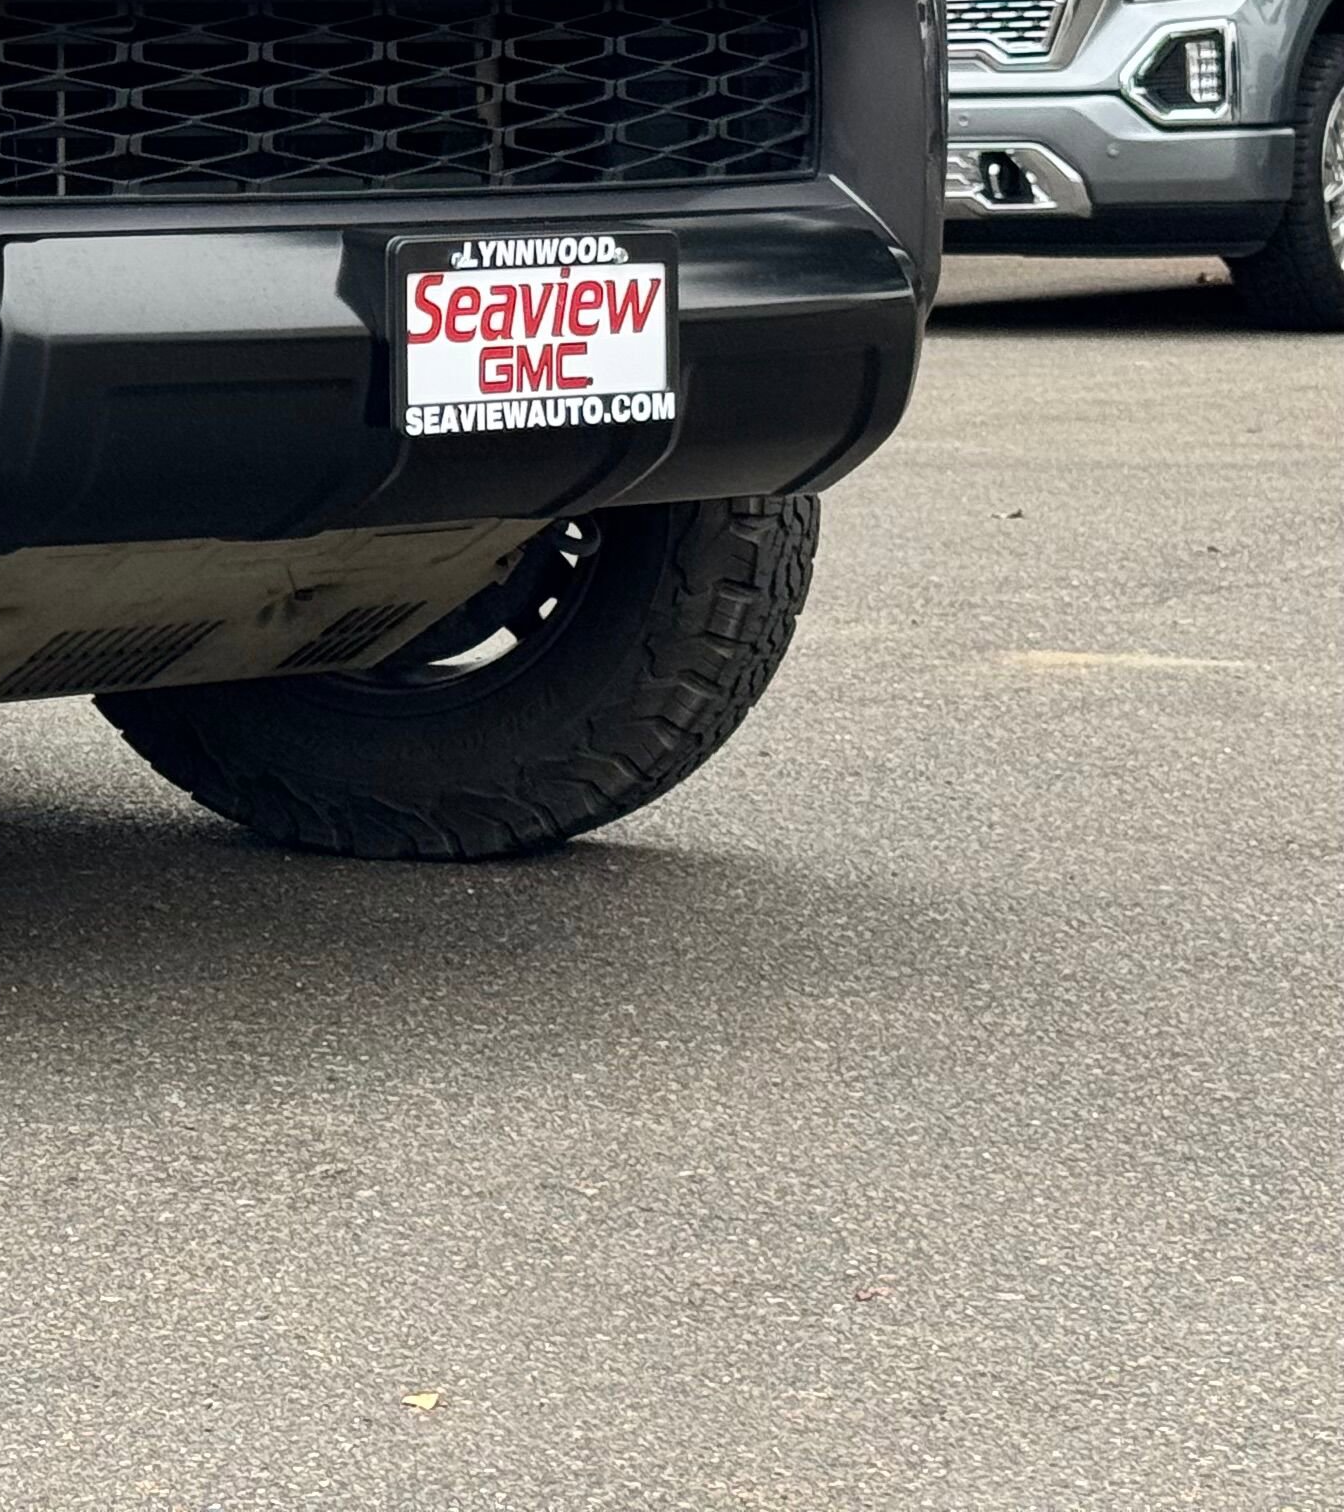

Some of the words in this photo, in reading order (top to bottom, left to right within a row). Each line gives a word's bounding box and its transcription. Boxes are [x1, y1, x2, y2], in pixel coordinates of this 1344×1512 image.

[459, 236, 617, 269] LYNNWOOD
[406, 266, 662, 345] Seaview
[478, 342, 589, 394] GMC
[405, 391, 676, 437] SEAVIEWAUTO.COM
